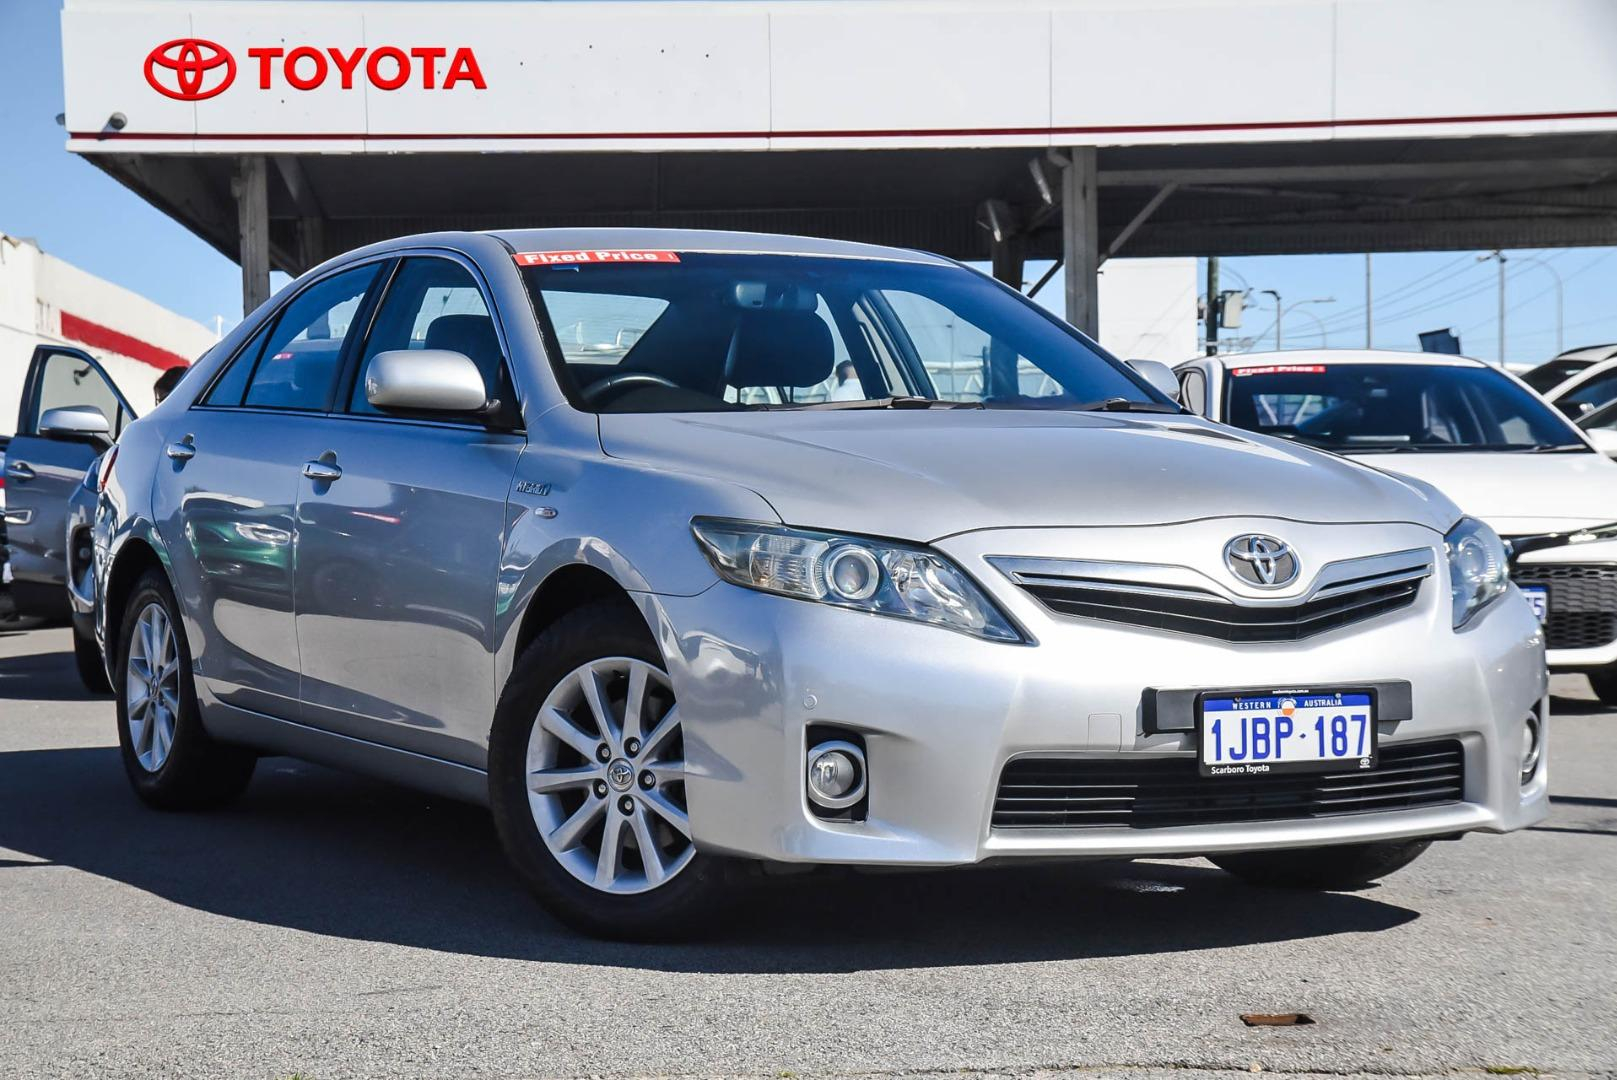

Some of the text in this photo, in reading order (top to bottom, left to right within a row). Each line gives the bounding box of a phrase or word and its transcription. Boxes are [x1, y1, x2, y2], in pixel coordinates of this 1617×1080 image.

[247, 46, 488, 91] TOYOTA
[524, 250, 659, 264] Fixed Price
[1232, 699, 1343, 710] WESTERN AUSTRALIA
[1210, 764, 1270, 775] Scarboro Toyota
